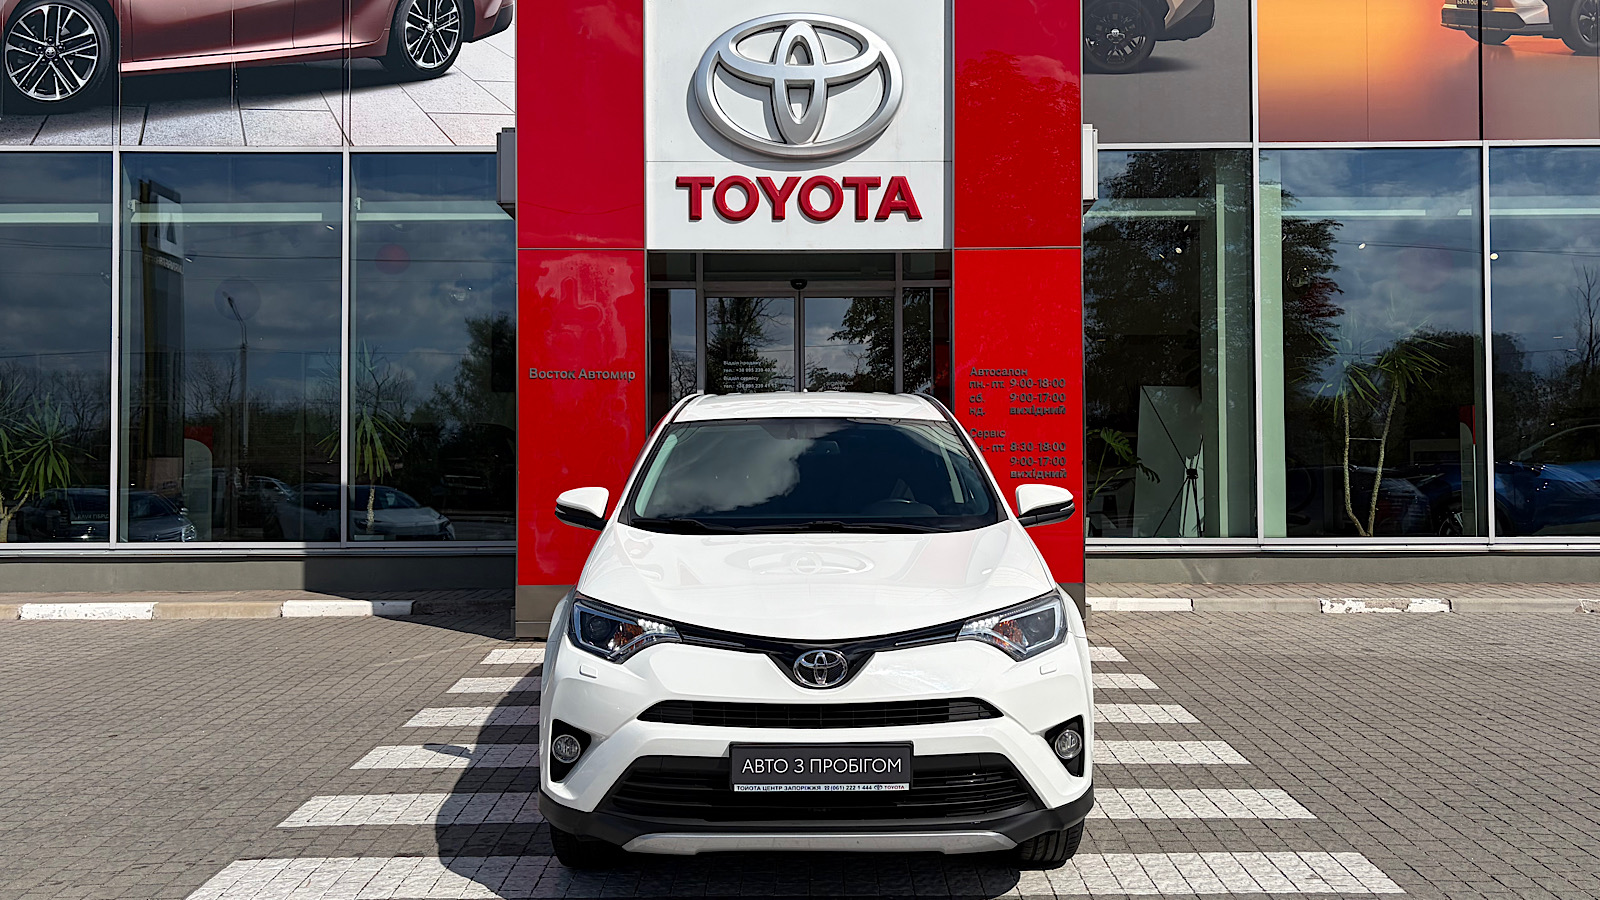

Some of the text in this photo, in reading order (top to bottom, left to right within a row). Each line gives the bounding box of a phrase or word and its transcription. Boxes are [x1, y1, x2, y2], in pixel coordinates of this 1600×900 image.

[675, 175, 923, 222] TOYOTA
[529, 367, 636, 382] Восток Автомир
[969, 367, 1028, 377] Автосалон
[991, 380, 1005, 389] пт.
[1009, 378, 1066, 389] 9:00-18:00
[969, 392, 1066, 403] сб. 9:00-17:00
[969, 404, 1066, 416] нд. вихідний
[969, 428, 1006, 439] Сервіс
[992, 444, 1006, 452] пт.
[1010, 442, 1066, 452] 8:30-18:00
[1010, 456, 1066, 467] 9:00-17:00
[1010, 468, 1067, 480] вихідний
[741, 758, 902, 774] АВТО З ПРОБІГОМ
